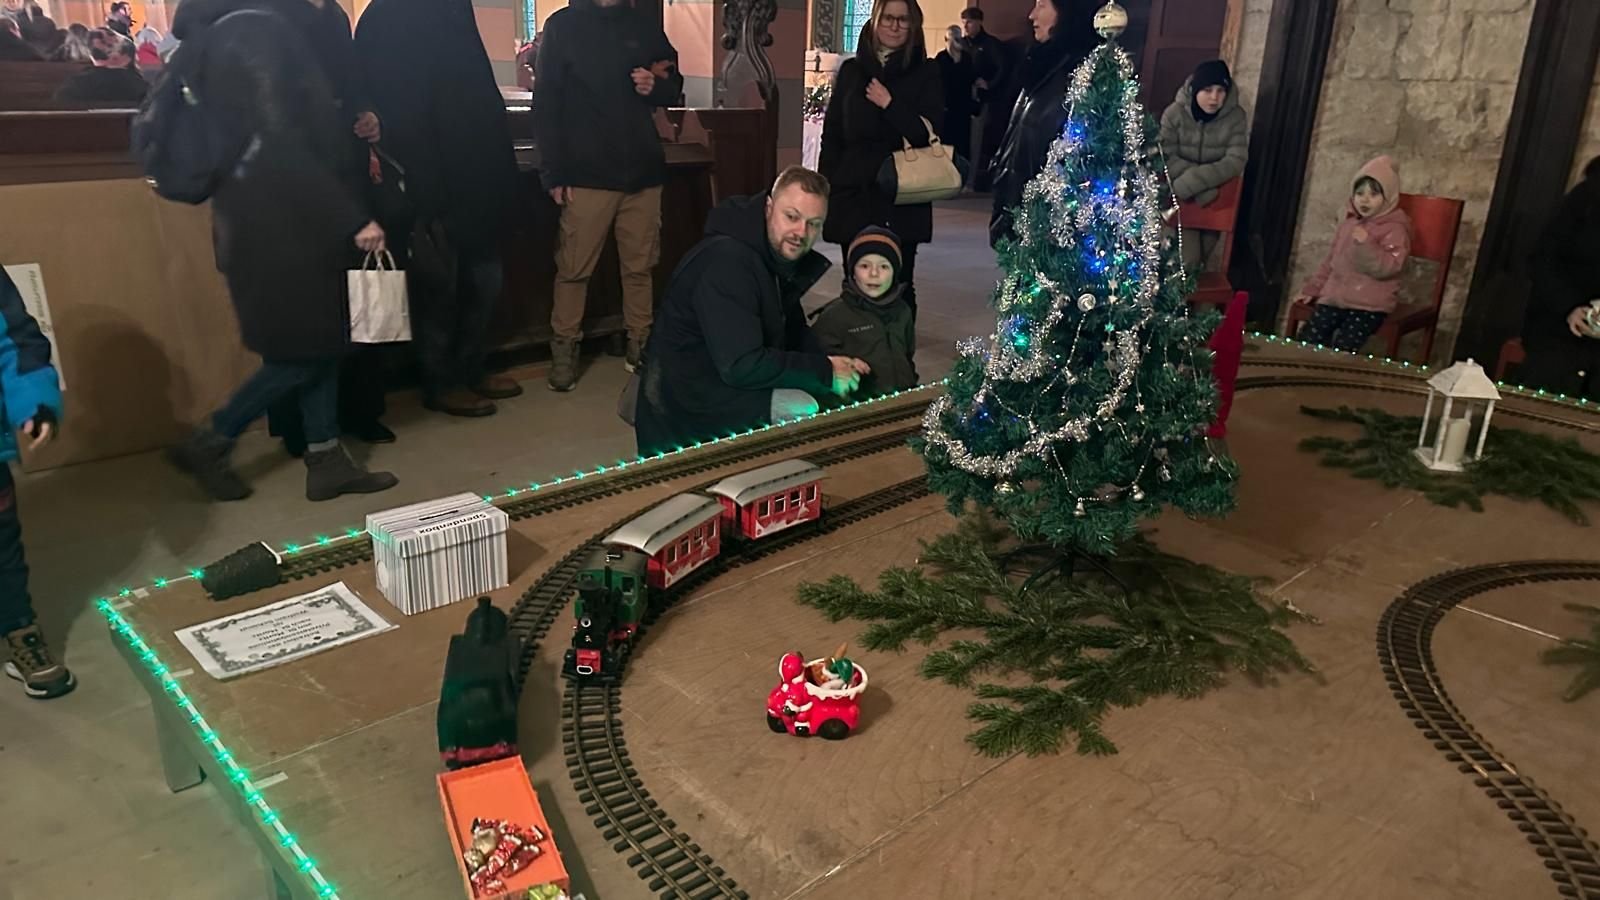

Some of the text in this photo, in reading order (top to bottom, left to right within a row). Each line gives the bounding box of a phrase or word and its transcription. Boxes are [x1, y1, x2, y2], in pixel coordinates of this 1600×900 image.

[419, 513, 487, 533] Spendenbox
[252, 629, 278, 638] Moritz
[259, 632, 284, 640] Moritz
